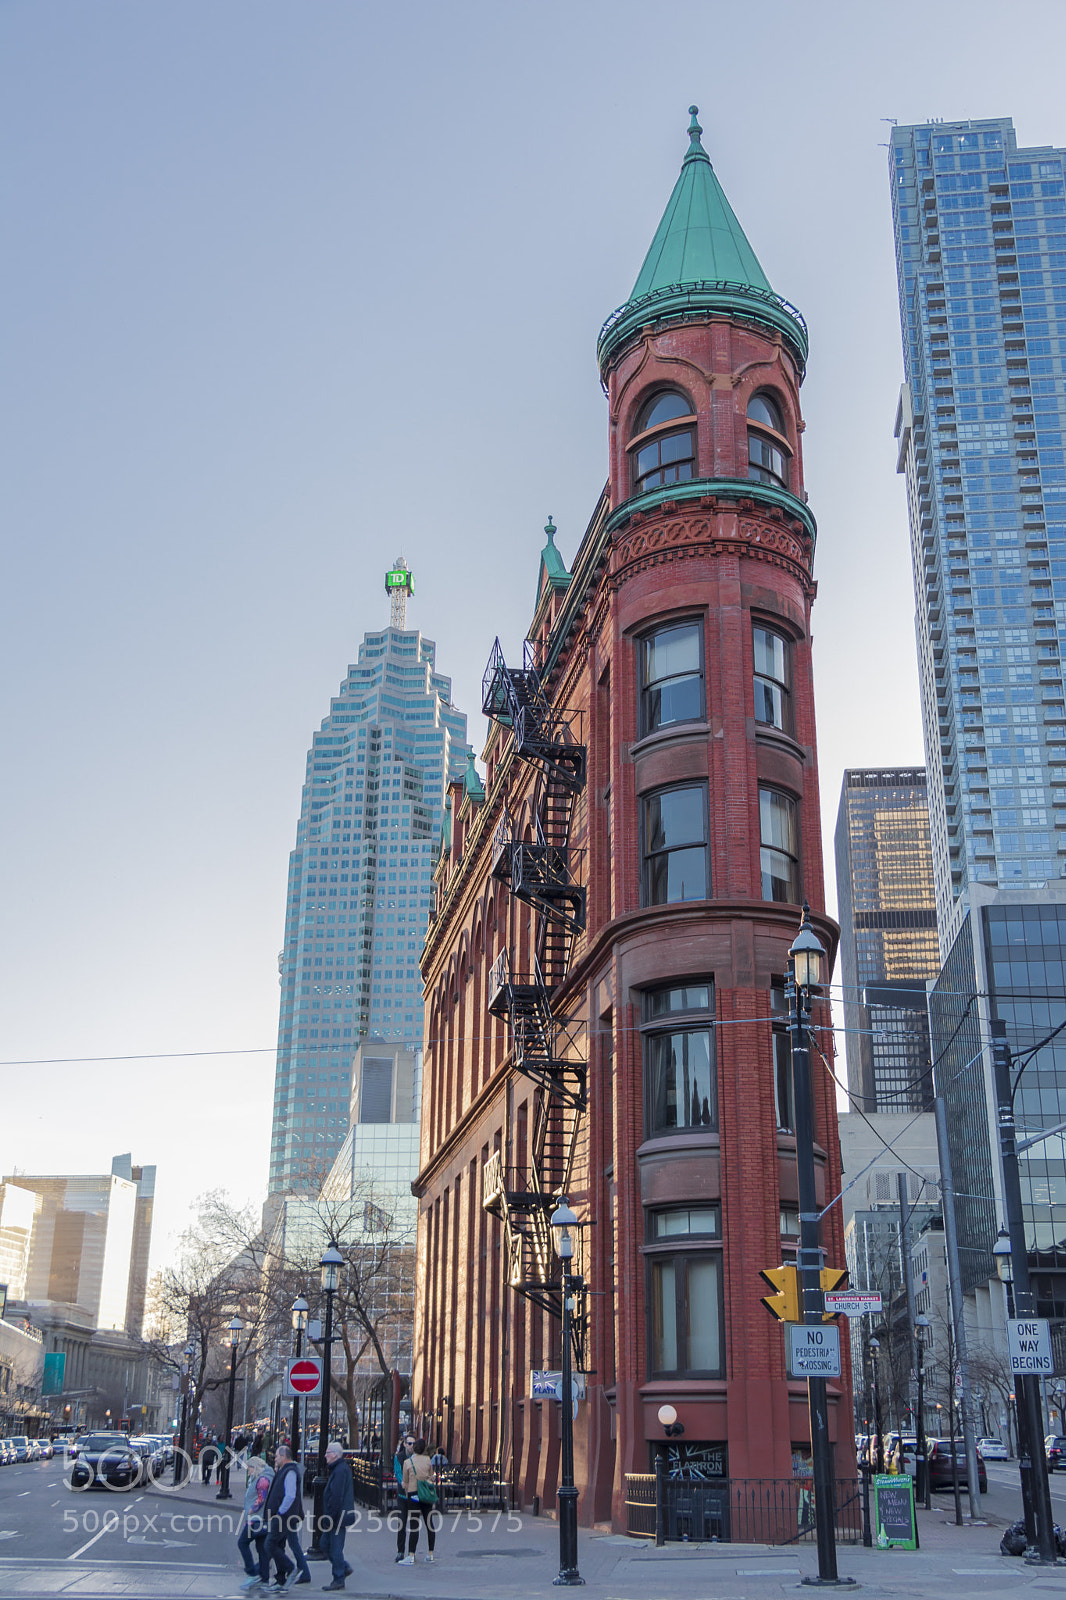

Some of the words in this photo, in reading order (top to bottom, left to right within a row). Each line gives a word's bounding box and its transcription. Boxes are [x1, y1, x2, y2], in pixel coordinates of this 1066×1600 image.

[390, 573, 405, 583] TD
[1017, 1323, 1039, 1336] ONE
[807, 1331, 823, 1345] NO
[1019, 1340, 1039, 1352] WAY
[1012, 1356, 1050, 1369] BEGINS
[702, 1452, 722, 1461] THE
